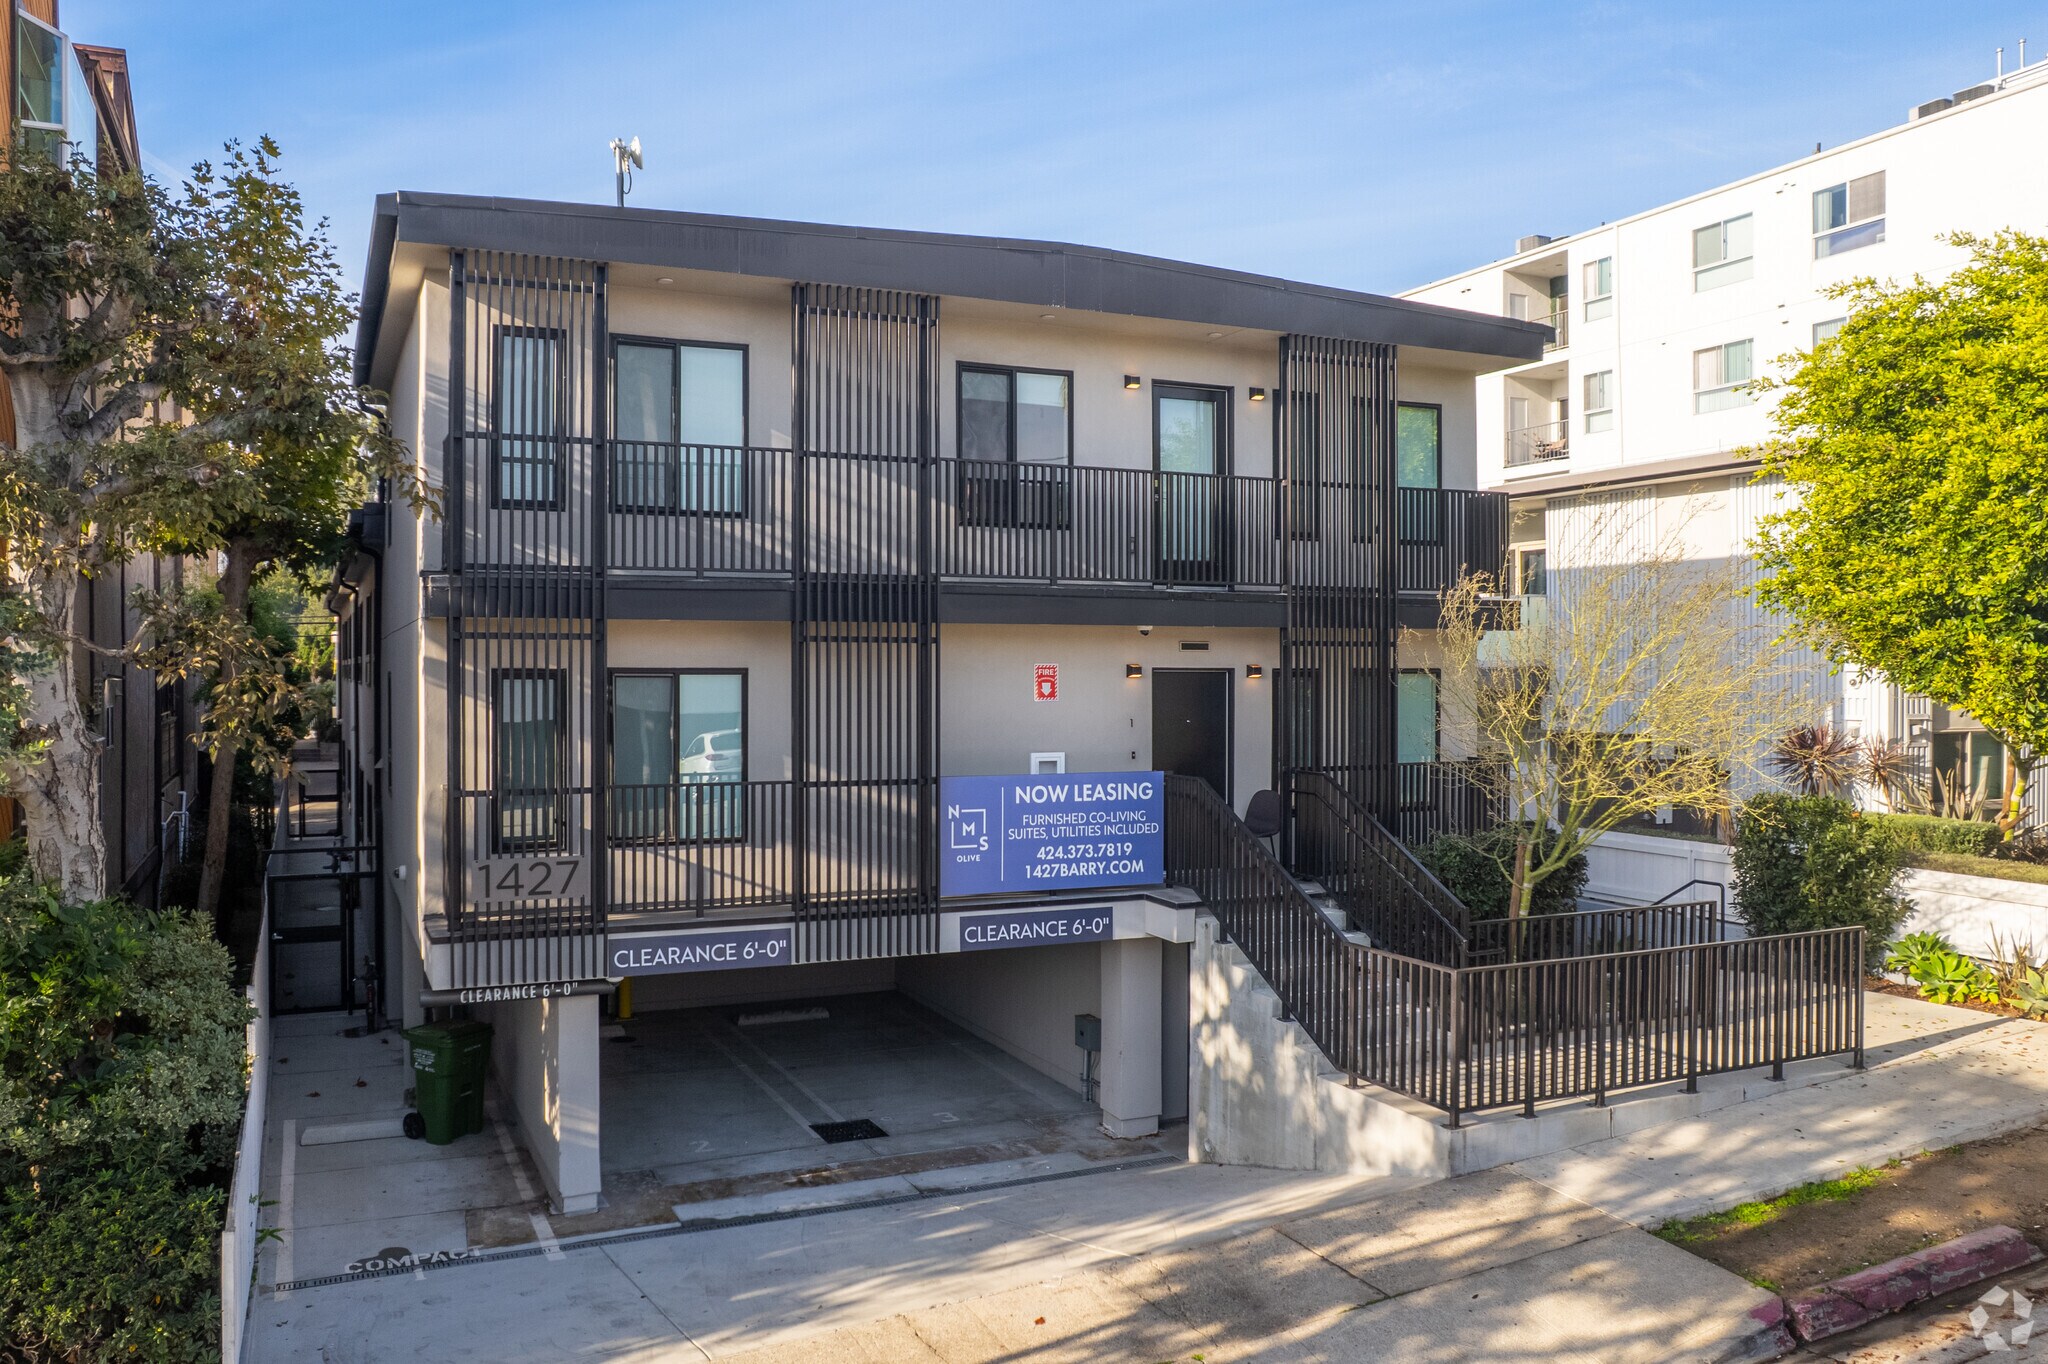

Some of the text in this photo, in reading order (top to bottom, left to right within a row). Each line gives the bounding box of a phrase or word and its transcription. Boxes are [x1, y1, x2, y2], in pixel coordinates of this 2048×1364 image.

[1038, 668, 1055, 676] FIRE
[1015, 782, 1153, 804] NOW LEASING
[1022, 810, 1147, 826] FURNISHED CO-LIVING
[1008, 822, 1159, 840] SUITES, UTILITIES INCLUDED
[956, 854, 981, 863] OLIVE
[1036, 842, 1133, 860] 424.373.7819
[477, 860, 580, 899] 1427
[1025, 859, 1144, 879] 1427BARRY.COM
[964, 917, 1110, 943] CLEARANCE 6'-0"
[613, 940, 787, 969] CLEARANCE 6'-0"
[460, 982, 578, 1004] CLEARANCE 6'-0"
[344, 1244, 484, 1274] COMPACT
